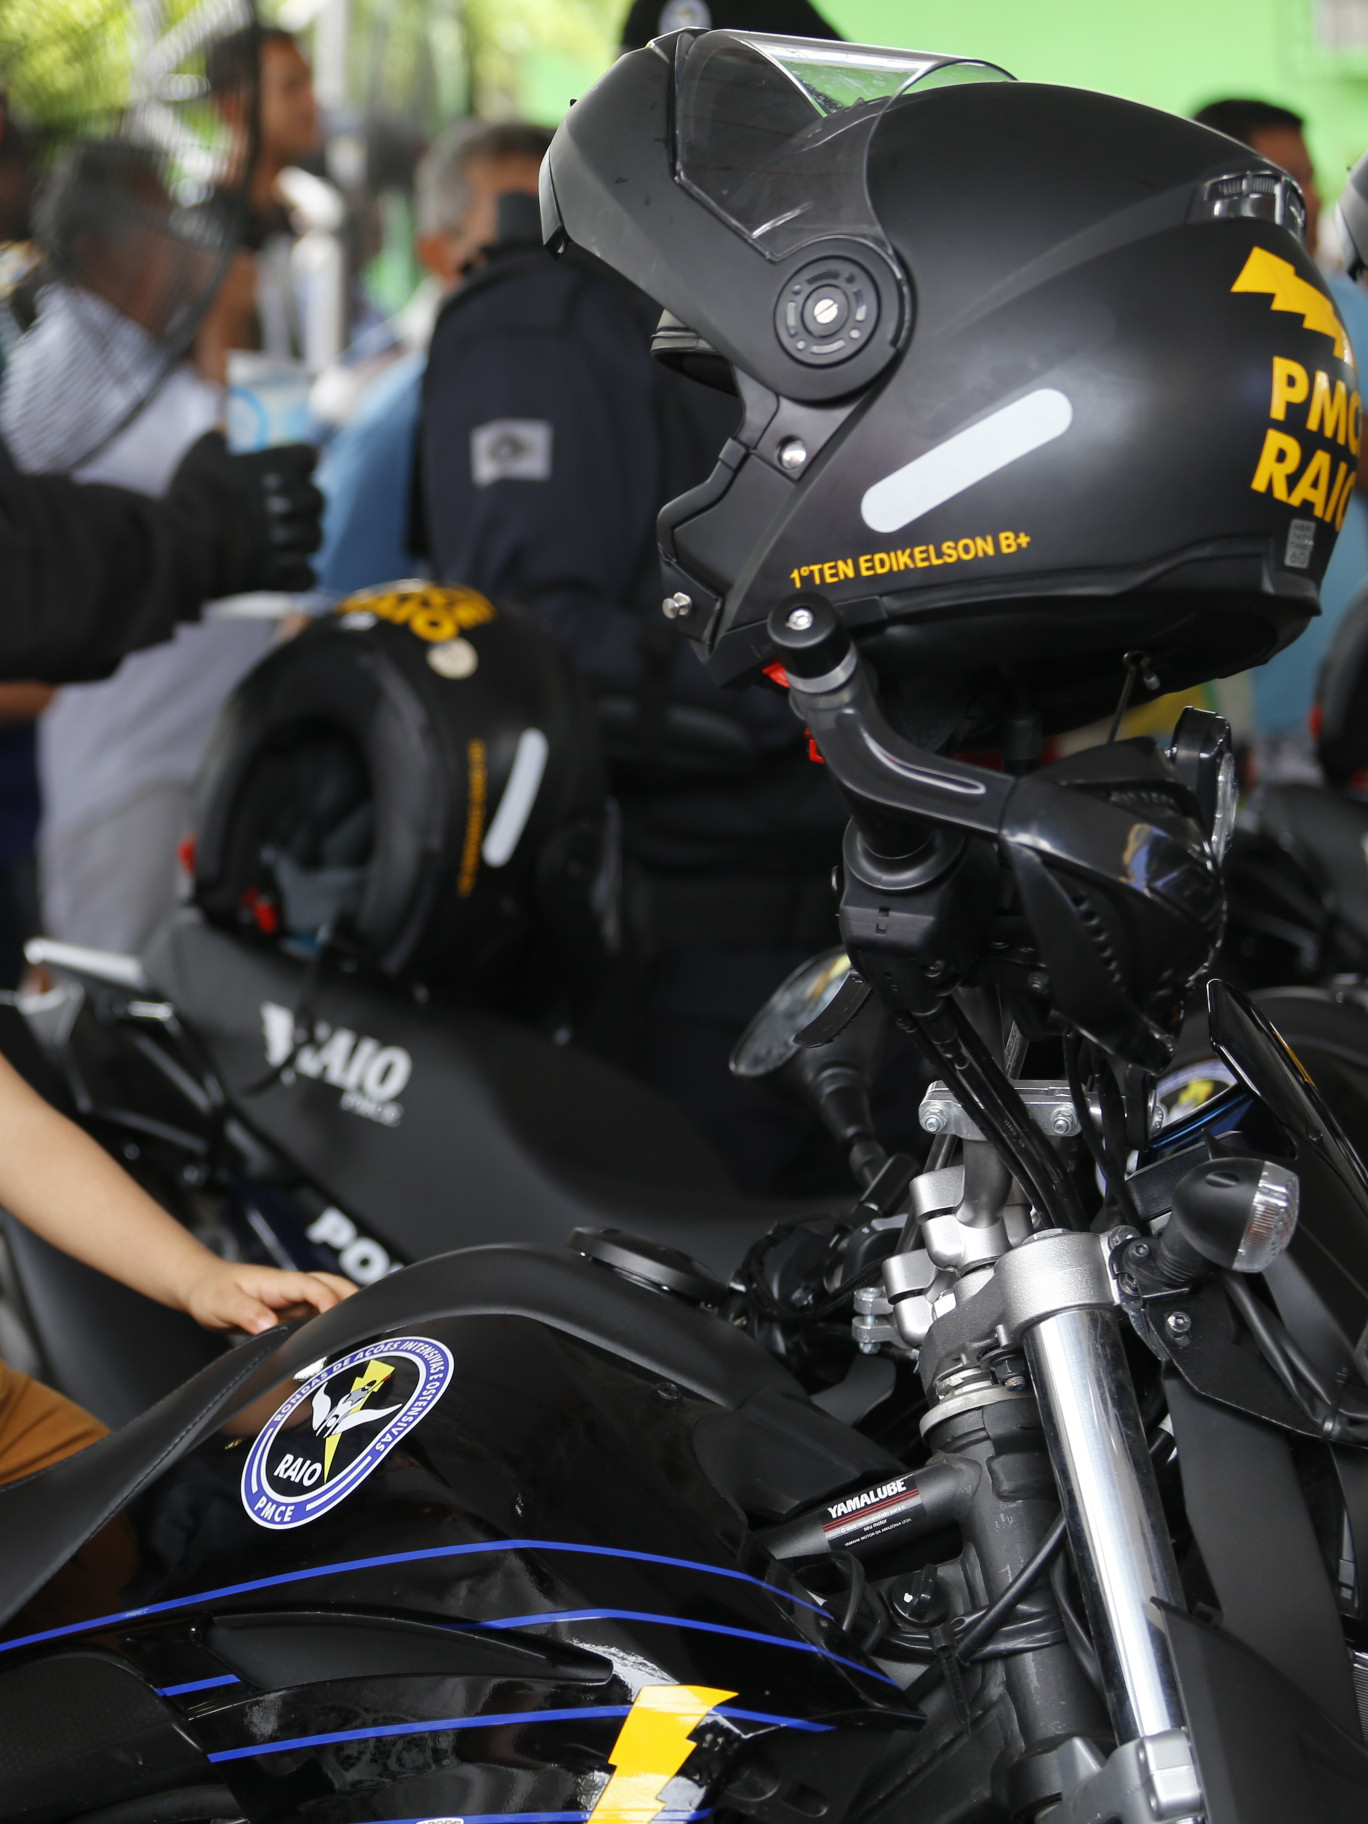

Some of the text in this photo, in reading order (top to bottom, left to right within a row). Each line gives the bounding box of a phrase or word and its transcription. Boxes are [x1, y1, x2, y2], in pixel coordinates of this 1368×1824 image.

[859, 535, 995, 577] EDIKELSON
[998, 531, 1031, 553] B+
[305, 1206, 404, 1286] PO
[332, 1358, 353, 1373] DE
[400, 1340, 444, 1374] INTENSIVAS
[273, 1370, 329, 1422] RONDAS
[375, 1380, 441, 1452] OSTENSIVAS
[273, 1453, 322, 1487] RAIO
[254, 1495, 295, 1522] PMCE
[827, 1480, 907, 1519] YAMALUBE
[873, 1519, 888, 1528] motor
